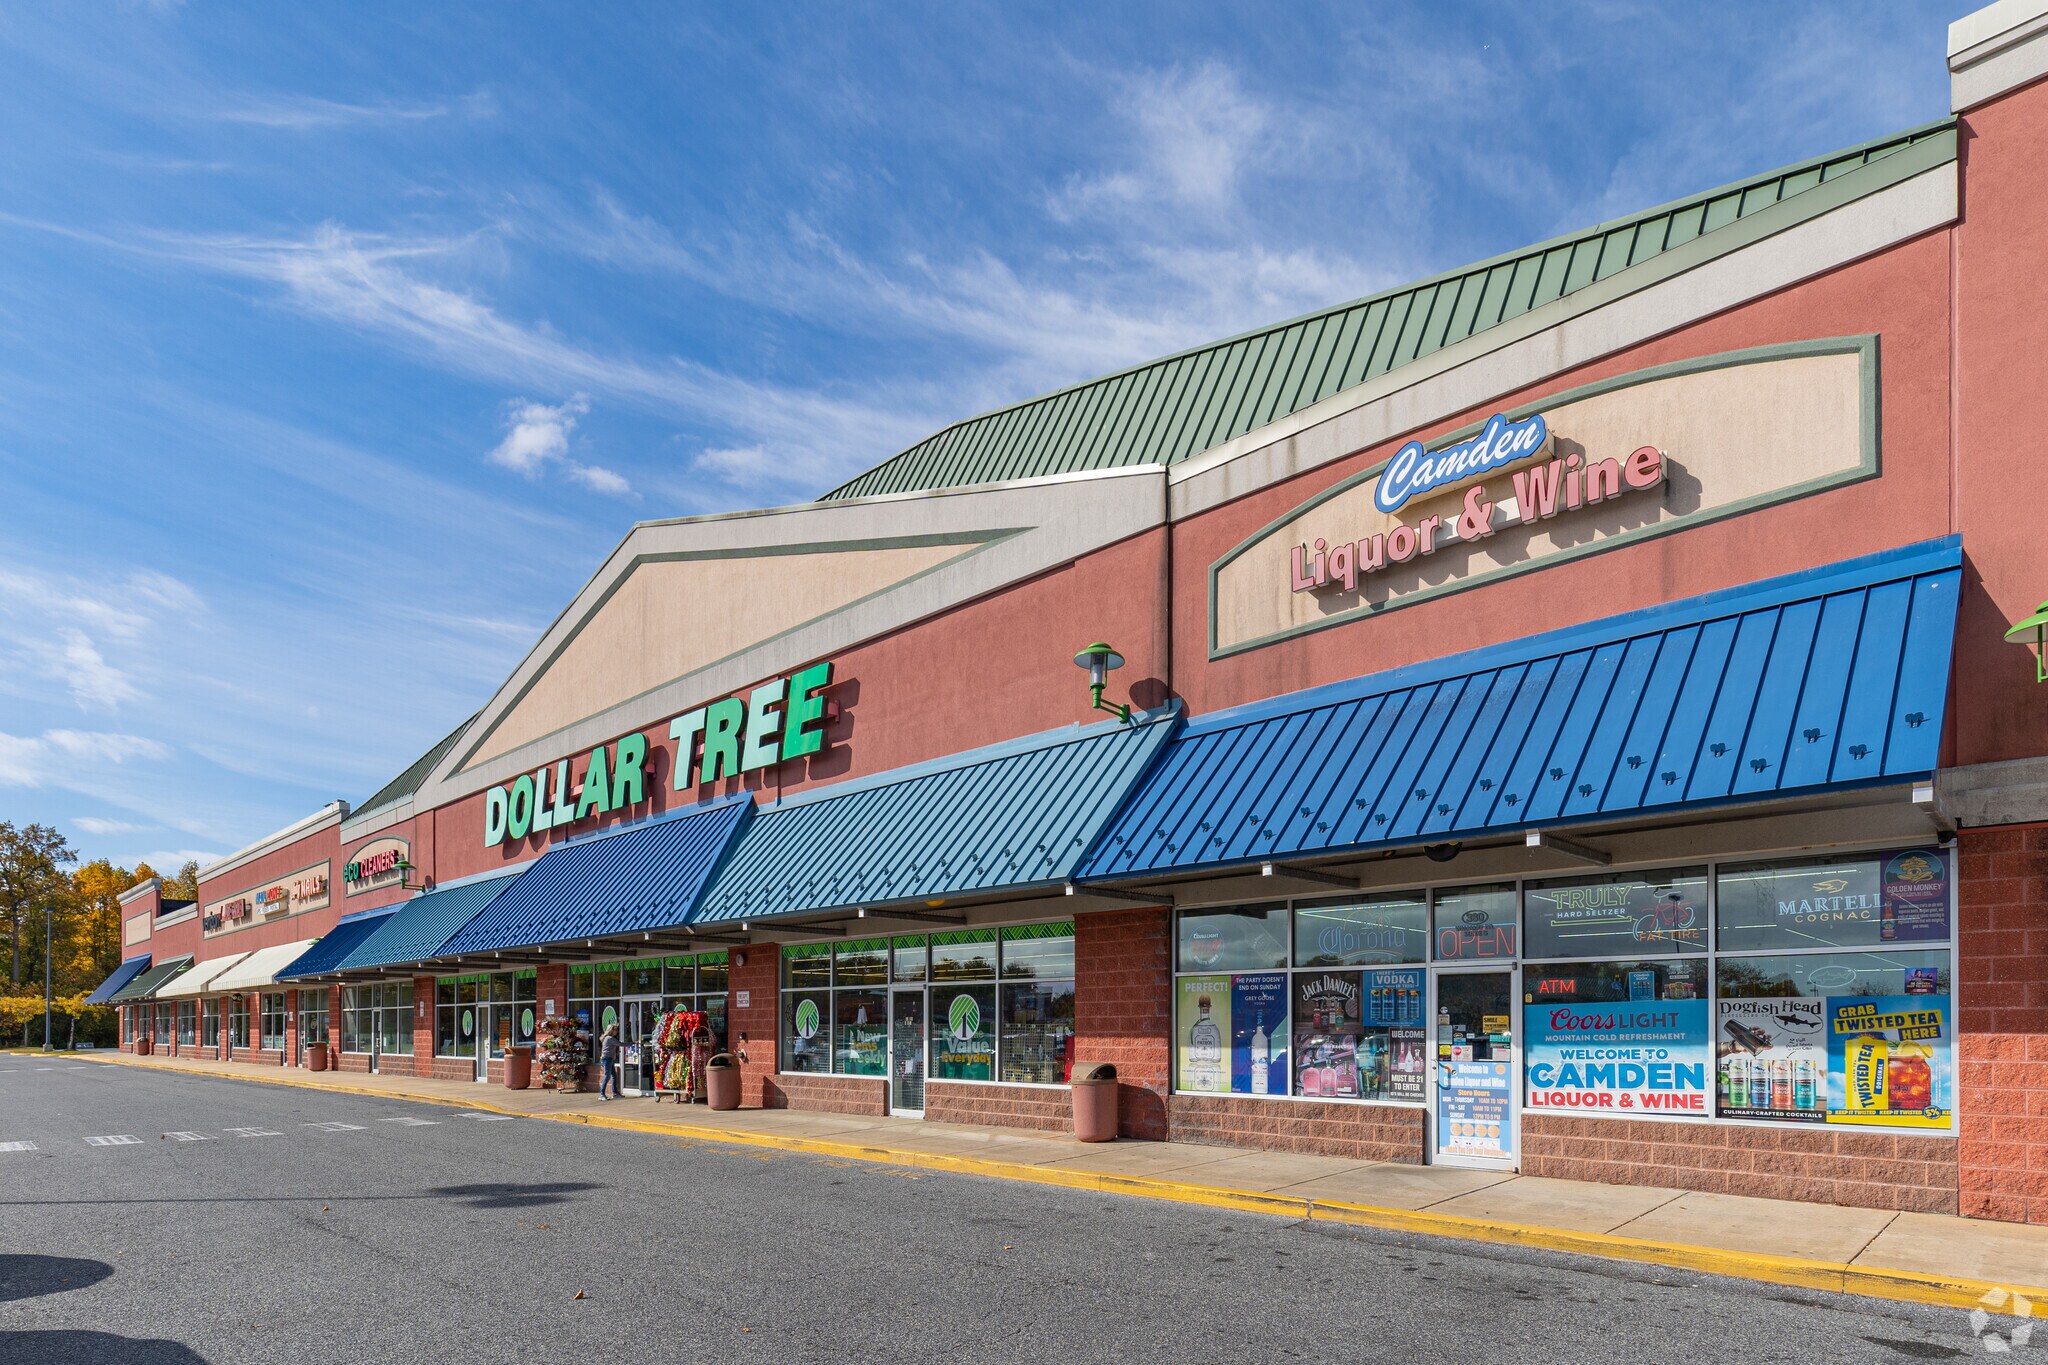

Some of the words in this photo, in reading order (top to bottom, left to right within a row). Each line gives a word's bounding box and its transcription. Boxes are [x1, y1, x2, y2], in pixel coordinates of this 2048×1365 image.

[1381, 418, 1540, 507] Camden
[1290, 513, 1440, 593] Liquor
[1456, 485, 1493, 540] &
[1512, 445, 1662, 524] Wine
[485, 732, 651, 848] DOLLAR
[669, 661, 834, 791] TREE
[360, 849, 396, 878] CLEANERS
[1886, 885, 1913, 893] GOLDEN
[1913, 883, 1941, 892] MONKEY
[1551, 885, 1632, 909] TRULY
[1557, 910, 1582, 918] HARD
[1585, 908, 1626, 917] SELTZER
[1794, 910, 1871, 923] COGNAC
[1318, 926, 1407, 956] Corona
[1440, 926, 1515, 957] OPEN
[1639, 931, 1663, 942] FAT
[1670, 930, 1700, 940] TIRE
[1185, 981, 1228, 993] PERFECT!
[1376, 975, 1415, 985] VODKA
[1539, 979, 1574, 993] ATM
[1301, 979, 1321, 1001] JACK
[1323, 974, 1358, 1000] DANIEL'S
[1720, 1002, 1778, 1014] Dogfish
[1782, 1000, 1822, 1015] Head
[1839, 1006, 1876, 1018] GRAB
[1549, 1008, 1616, 1031] Coors
[1618, 1012, 1679, 1029] LIGHT
[1837, 1014, 1905, 1032] TWISTED
[1909, 1012, 1938, 1026] TEA
[857, 1029, 881, 1042] New
[1392, 1030, 1424, 1039] WELCOME
[1545, 1034, 1591, 1042] MOUNTAIN
[1592, 1033, 1617, 1041] COLD
[1619, 1032, 1686, 1041] REFRESHMENT
[1902, 1026, 1938, 1040] HERE
[947, 1037, 989, 1054] Value
[1858, 1043, 1875, 1062] TEA
[941, 1051, 991, 1066] Everyday
[1559, 1049, 1641, 1060] WELCOME
[1645, 1048, 1669, 1060] TO
[1458, 1064, 1482, 1074] Welcome
[1530, 1062, 1705, 1090] CAMDEN
[1391, 1074, 1407, 1082] MUST
[1416, 1075, 1423, 1083] 21
[1876, 1063, 1884, 1090] ORIGINAL
[1394, 1082, 1402, 1090] TO
[1402, 1083, 1420, 1091] ENTER
[1856, 1063, 1875, 1108] TWISTED
[1532, 1091, 1614, 1107] LIQUOR
[1618, 1092, 1634, 1108] &
[1639, 1093, 1705, 1110] WINE
[1786, 1111, 1822, 1119] COCKTAILS
[1925, 1108, 1940, 1117] 5%
